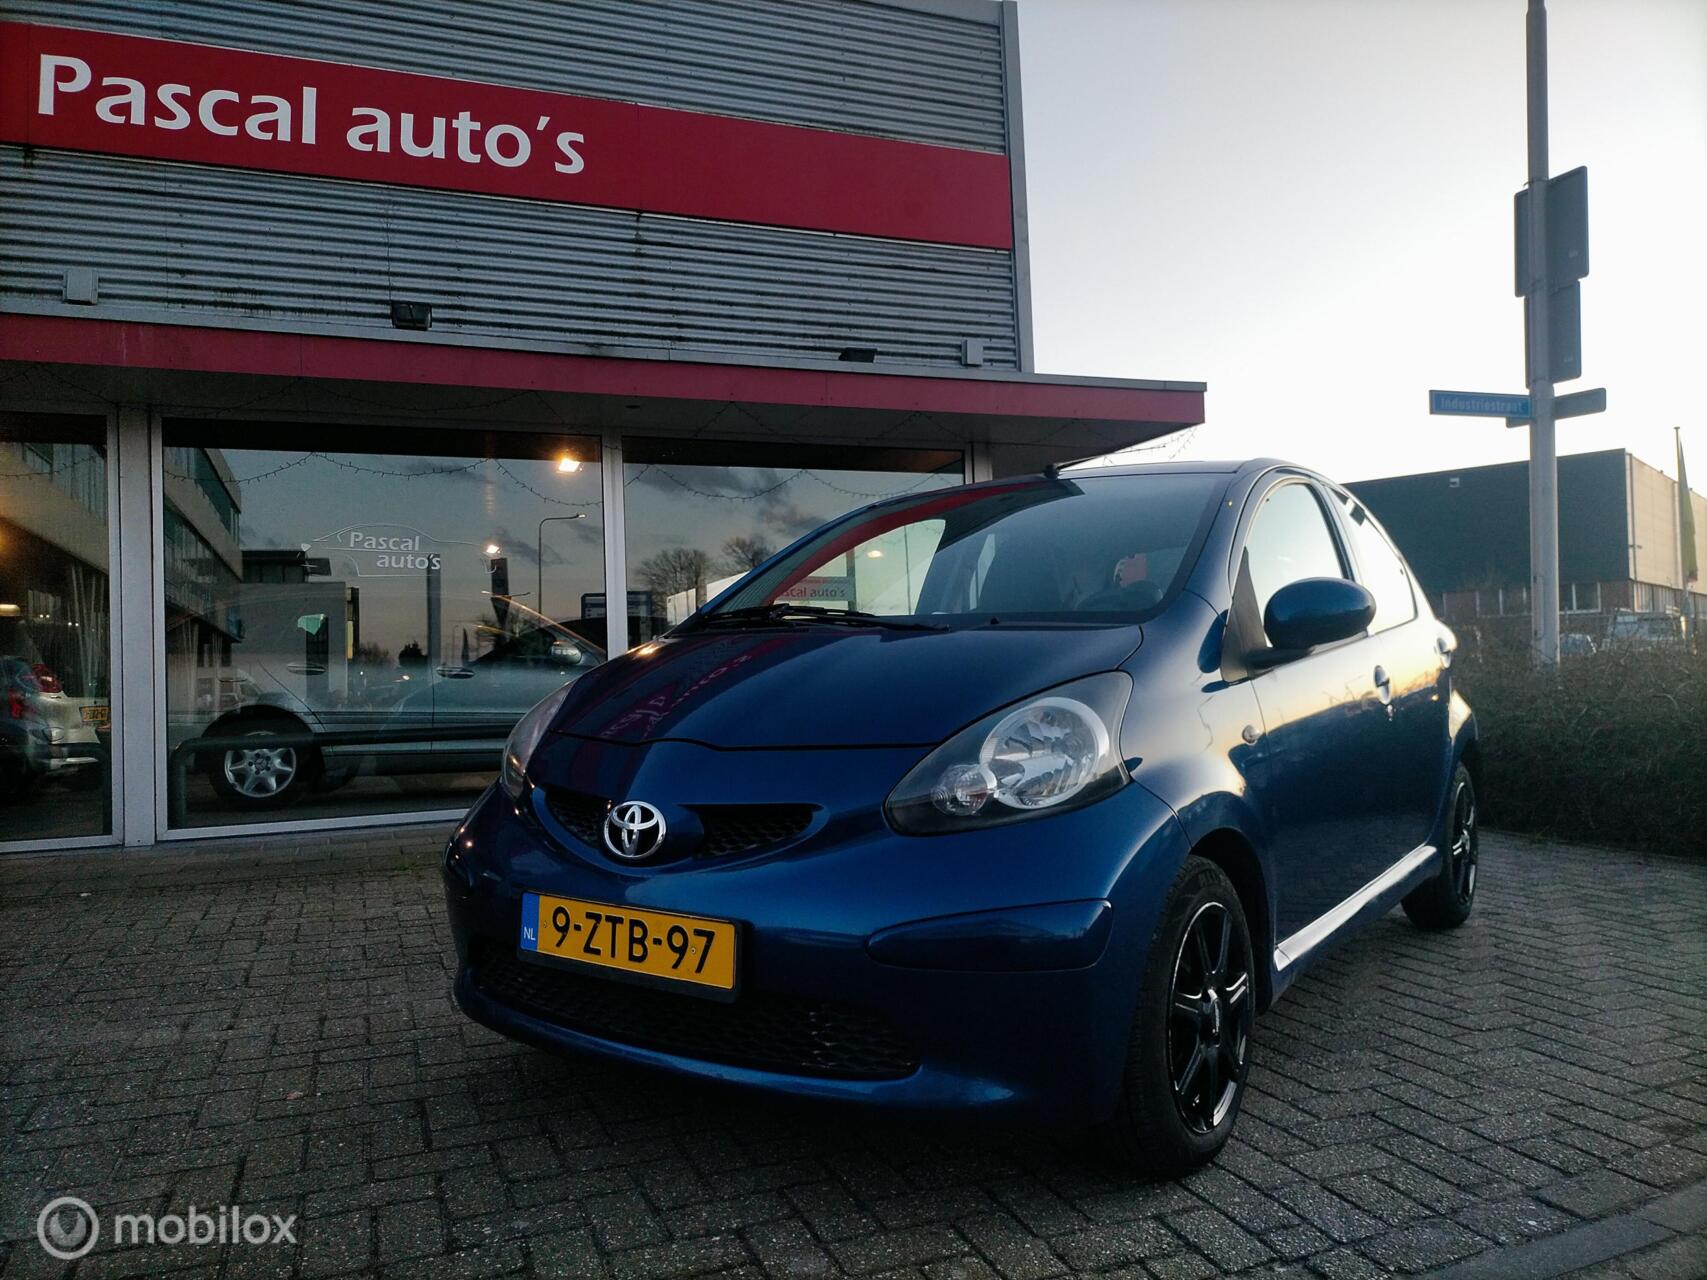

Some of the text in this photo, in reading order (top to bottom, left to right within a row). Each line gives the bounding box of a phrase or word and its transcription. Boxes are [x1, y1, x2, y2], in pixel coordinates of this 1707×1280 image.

[38, 53, 586, 175] Pascal auto's
[349, 531, 420, 551] Pascal
[376, 553, 441, 571] auto's
[523, 926, 536, 941] NL
[552, 905, 716, 975] 9-ZTB-97
